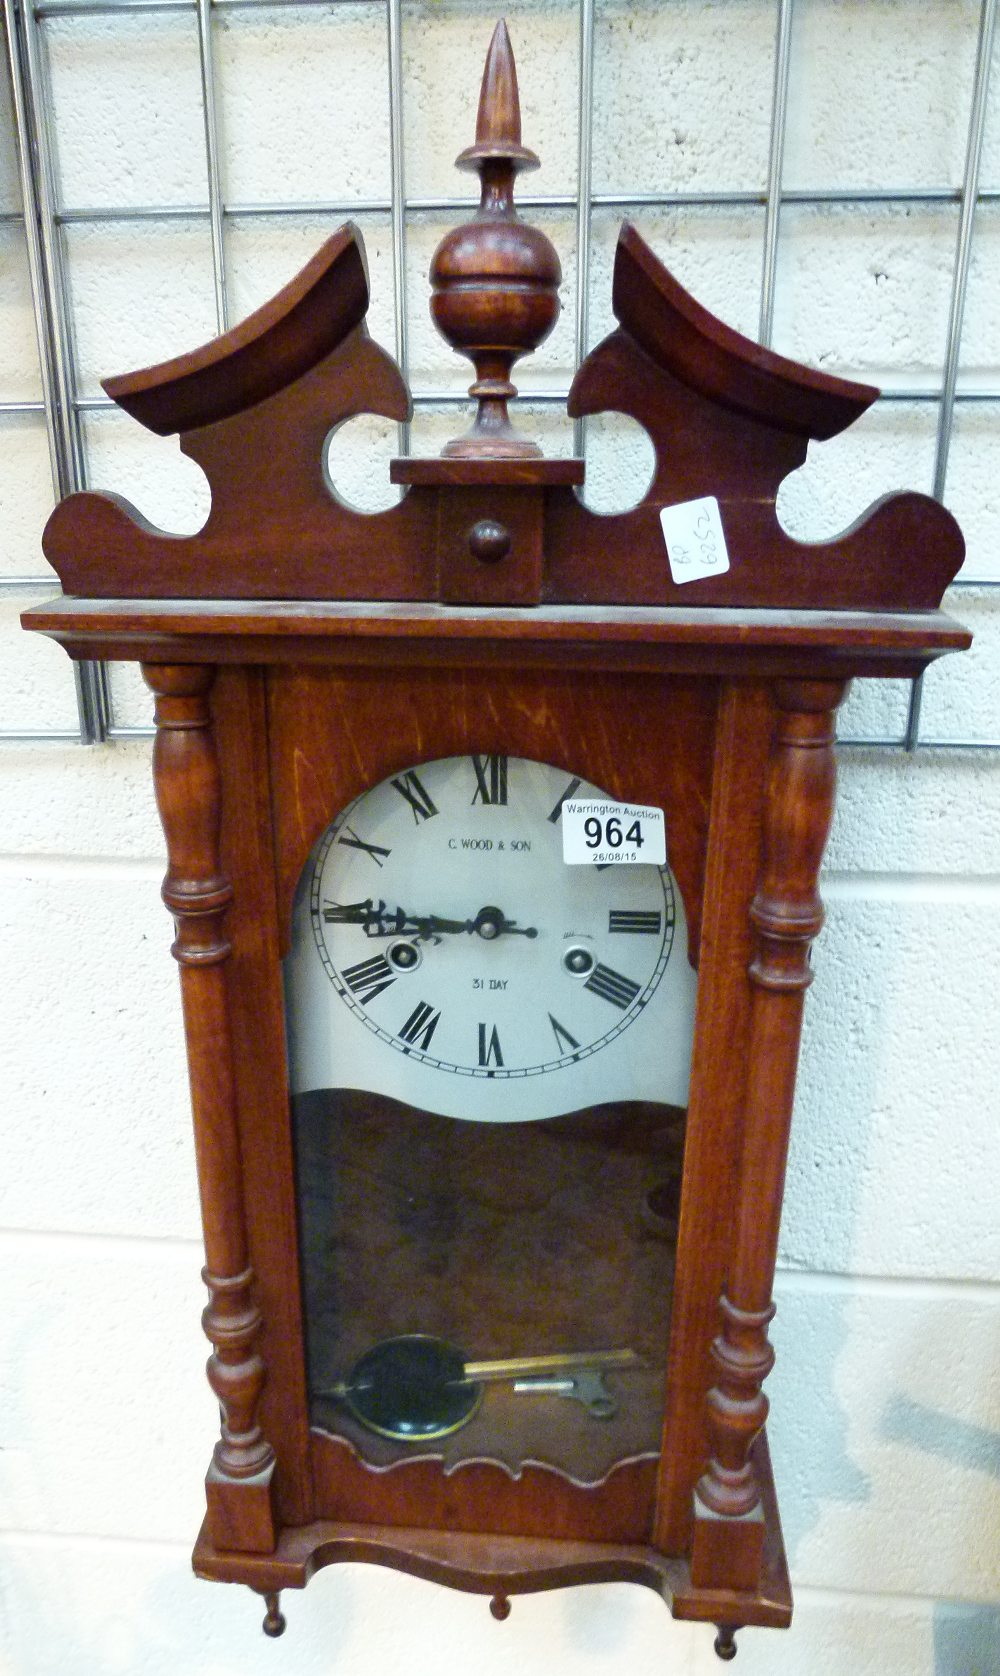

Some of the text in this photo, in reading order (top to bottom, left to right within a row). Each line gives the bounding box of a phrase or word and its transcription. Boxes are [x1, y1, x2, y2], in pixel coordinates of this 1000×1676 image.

[567, 803, 660, 820] Warrington Auction
[584, 817, 645, 849] 964
[461, 838, 493, 851] WOOD
[498, 840, 505, 850] &
[510, 840, 531, 852] SON
[592, 852, 637, 862] 26/08/15
[472, 978, 509, 990] 31 DAY
